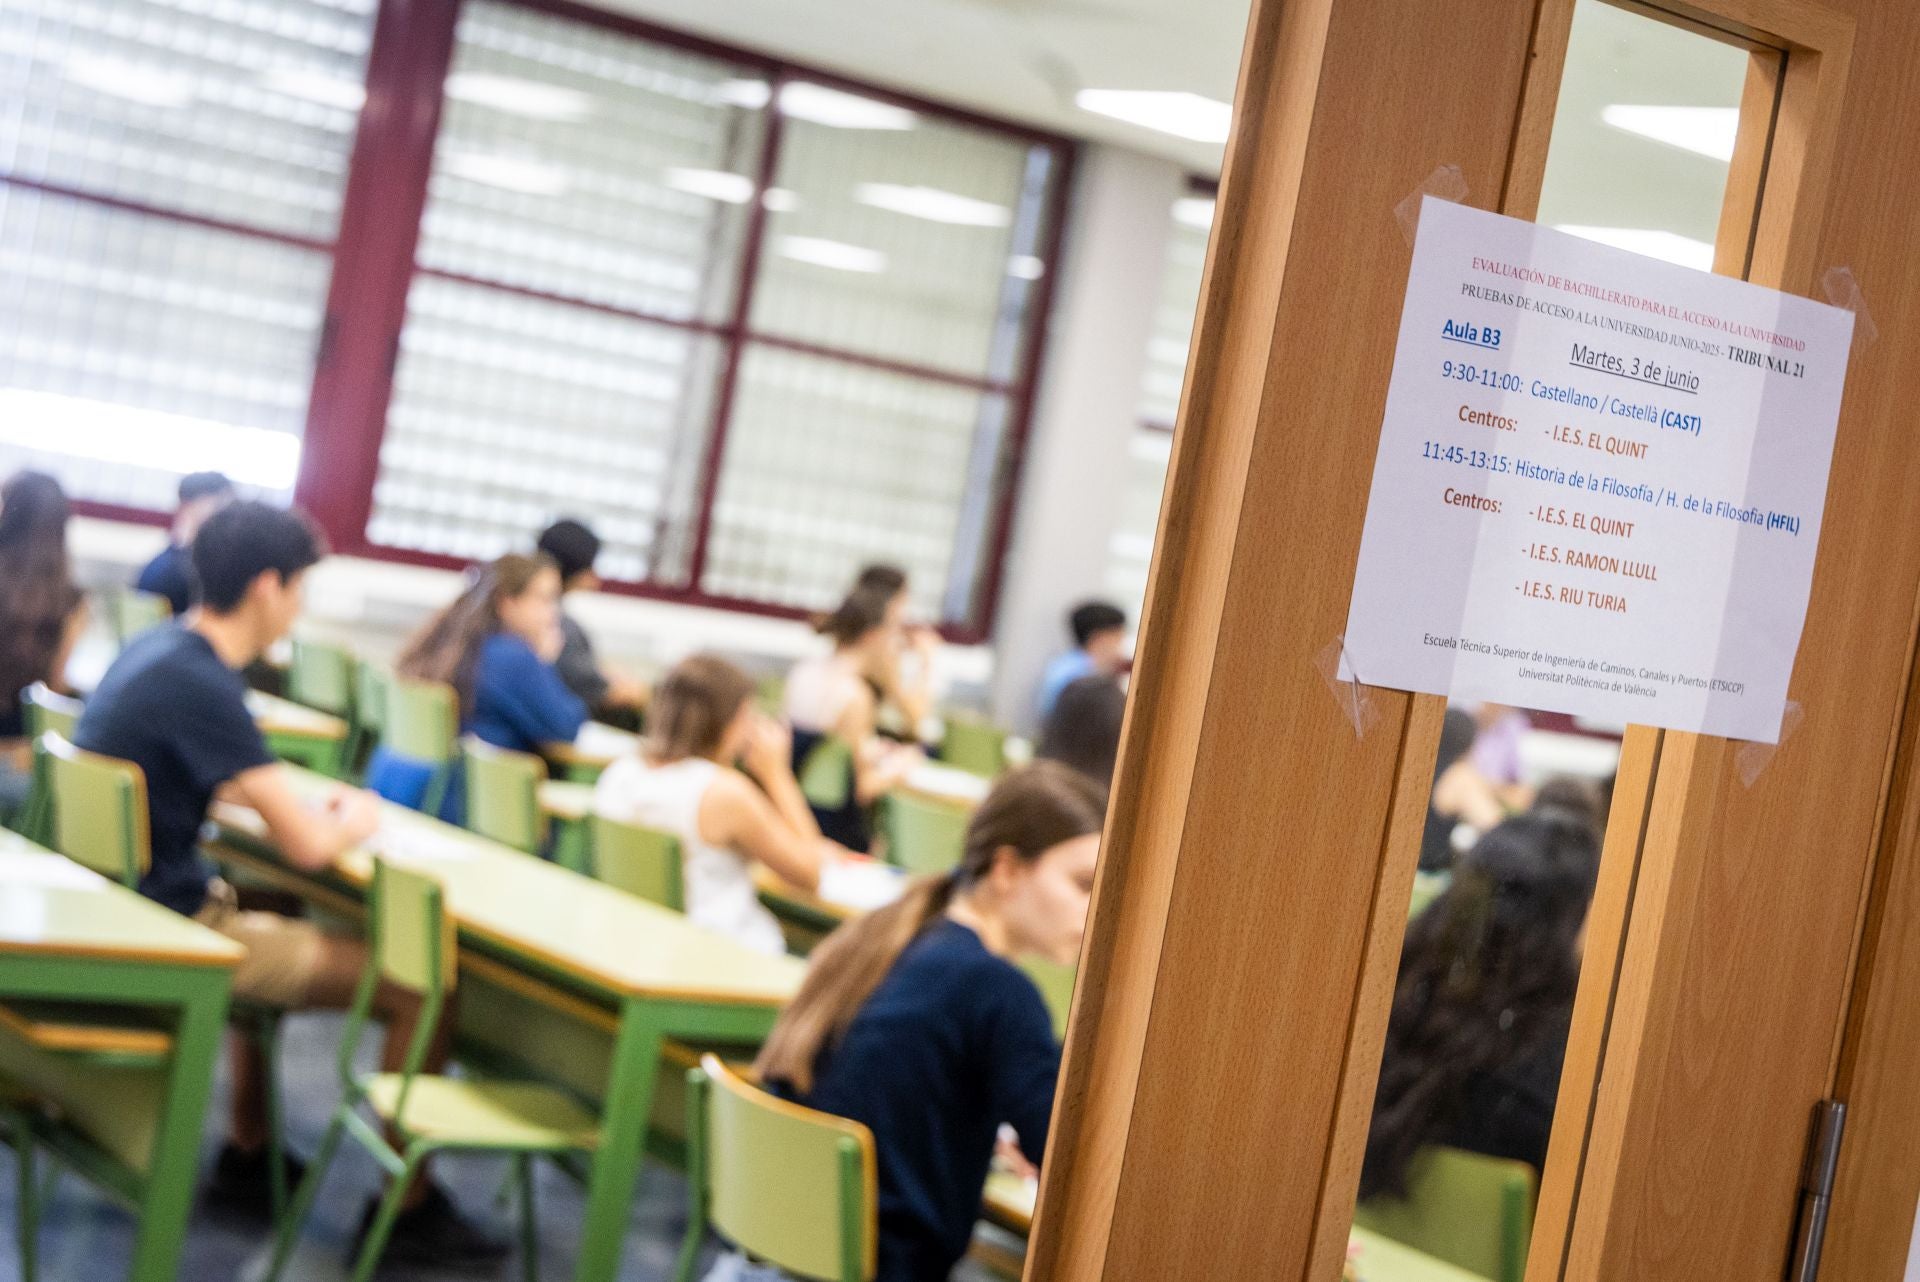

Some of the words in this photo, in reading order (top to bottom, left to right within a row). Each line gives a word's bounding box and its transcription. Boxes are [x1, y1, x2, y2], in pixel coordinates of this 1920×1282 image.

[1461, 283, 1514, 306] PRUEBAS
[1516, 296, 1530, 310] DE
[1532, 301, 1574, 320] ACCESO
[1576, 312, 1582, 323] A
[1584, 312, 1598, 327] LA
[1600, 316, 1668, 343] UNIVERSIDAD
[1729, 346, 1788, 374] TRIBUNAL
[1793, 362, 1804, 378] 21
[1472, 257, 1545, 285] EVALUACIÓN
[1547, 275, 1562, 289] DE
[1563, 279, 1640, 308] BACHILLERATO
[1641, 299, 1666, 316] PARA
[1668, 305, 1680, 320] EL
[1681, 310, 1720, 329] ACCESO
[1722, 320, 1728, 332] A
[1729, 322, 1741, 336] LA
[1743, 326, 1805, 352] UNIVERSIDAD
[1442, 319, 1477, 341] Aula
[1481, 327, 1501, 346] B3
[1570, 343, 1627, 375] Martes,
[1630, 357, 1640, 376] 3
[1643, 360, 1662, 382] de
[1664, 366, 1700, 391] junio
[1442, 361, 1523, 393] 9:30-11:00:
[1531, 380, 1598, 409] Castellano
[1599, 394, 1609, 415] /
[1611, 398, 1658, 423] Castellà
[1661, 409, 1701, 436] (CAST)
[1459, 405, 1518, 432] Centros:
[1553, 425, 1583, 446] I.E.S.
[1588, 432, 1602, 450] EL
[1605, 437, 1648, 459] QUINT
[1423, 441, 1511, 473] 11:45-13:15:
[1515, 459, 1565, 484] Historia
[1568, 470, 1584, 488] de
[1587, 473, 1599, 491] la
[1602, 477, 1653, 502] Filosofía
[1655, 487, 1664, 507] /
[1666, 490, 1678, 508] H.
[1683, 494, 1699, 512] de
[1702, 497, 1713, 515] la
[1767, 511, 1800, 536] (HFIL)
[1444, 488, 1502, 513] Centros:
[1537, 505, 1568, 526] I.E.S.
[1572, 512, 1586, 530] EL
[1590, 516, 1634, 538] QUINT
[1530, 543, 1561, 563] I.E.S.
[1566, 550, 1619, 574] RAMON
[1622, 560, 1657, 581] LLULL
[1523, 580, 1555, 600] I.E.S.
[1560, 587, 1584, 605] RIU
[1588, 591, 1626, 613] TURIA
[1423, 633, 1457, 649] Escuela
[1460, 638, 1491, 655] Técnica
[1493, 644, 1530, 660] Superior
[1531, 650, 1543, 662] de
[1544, 653, 1586, 669] Ingeniería
[1587, 659, 1599, 671] de
[1600, 661, 1637, 679] Caminos,
[1639, 667, 1669, 682] Canales
[1671, 675, 1677, 685] y
[1677, 673, 1708, 688] Puertos
[1709, 679, 1744, 696] (ETSICCP)
[1518, 667, 1564, 683] Universitat
[1611, 681, 1622, 693] de
[1624, 682, 1656, 698] València
